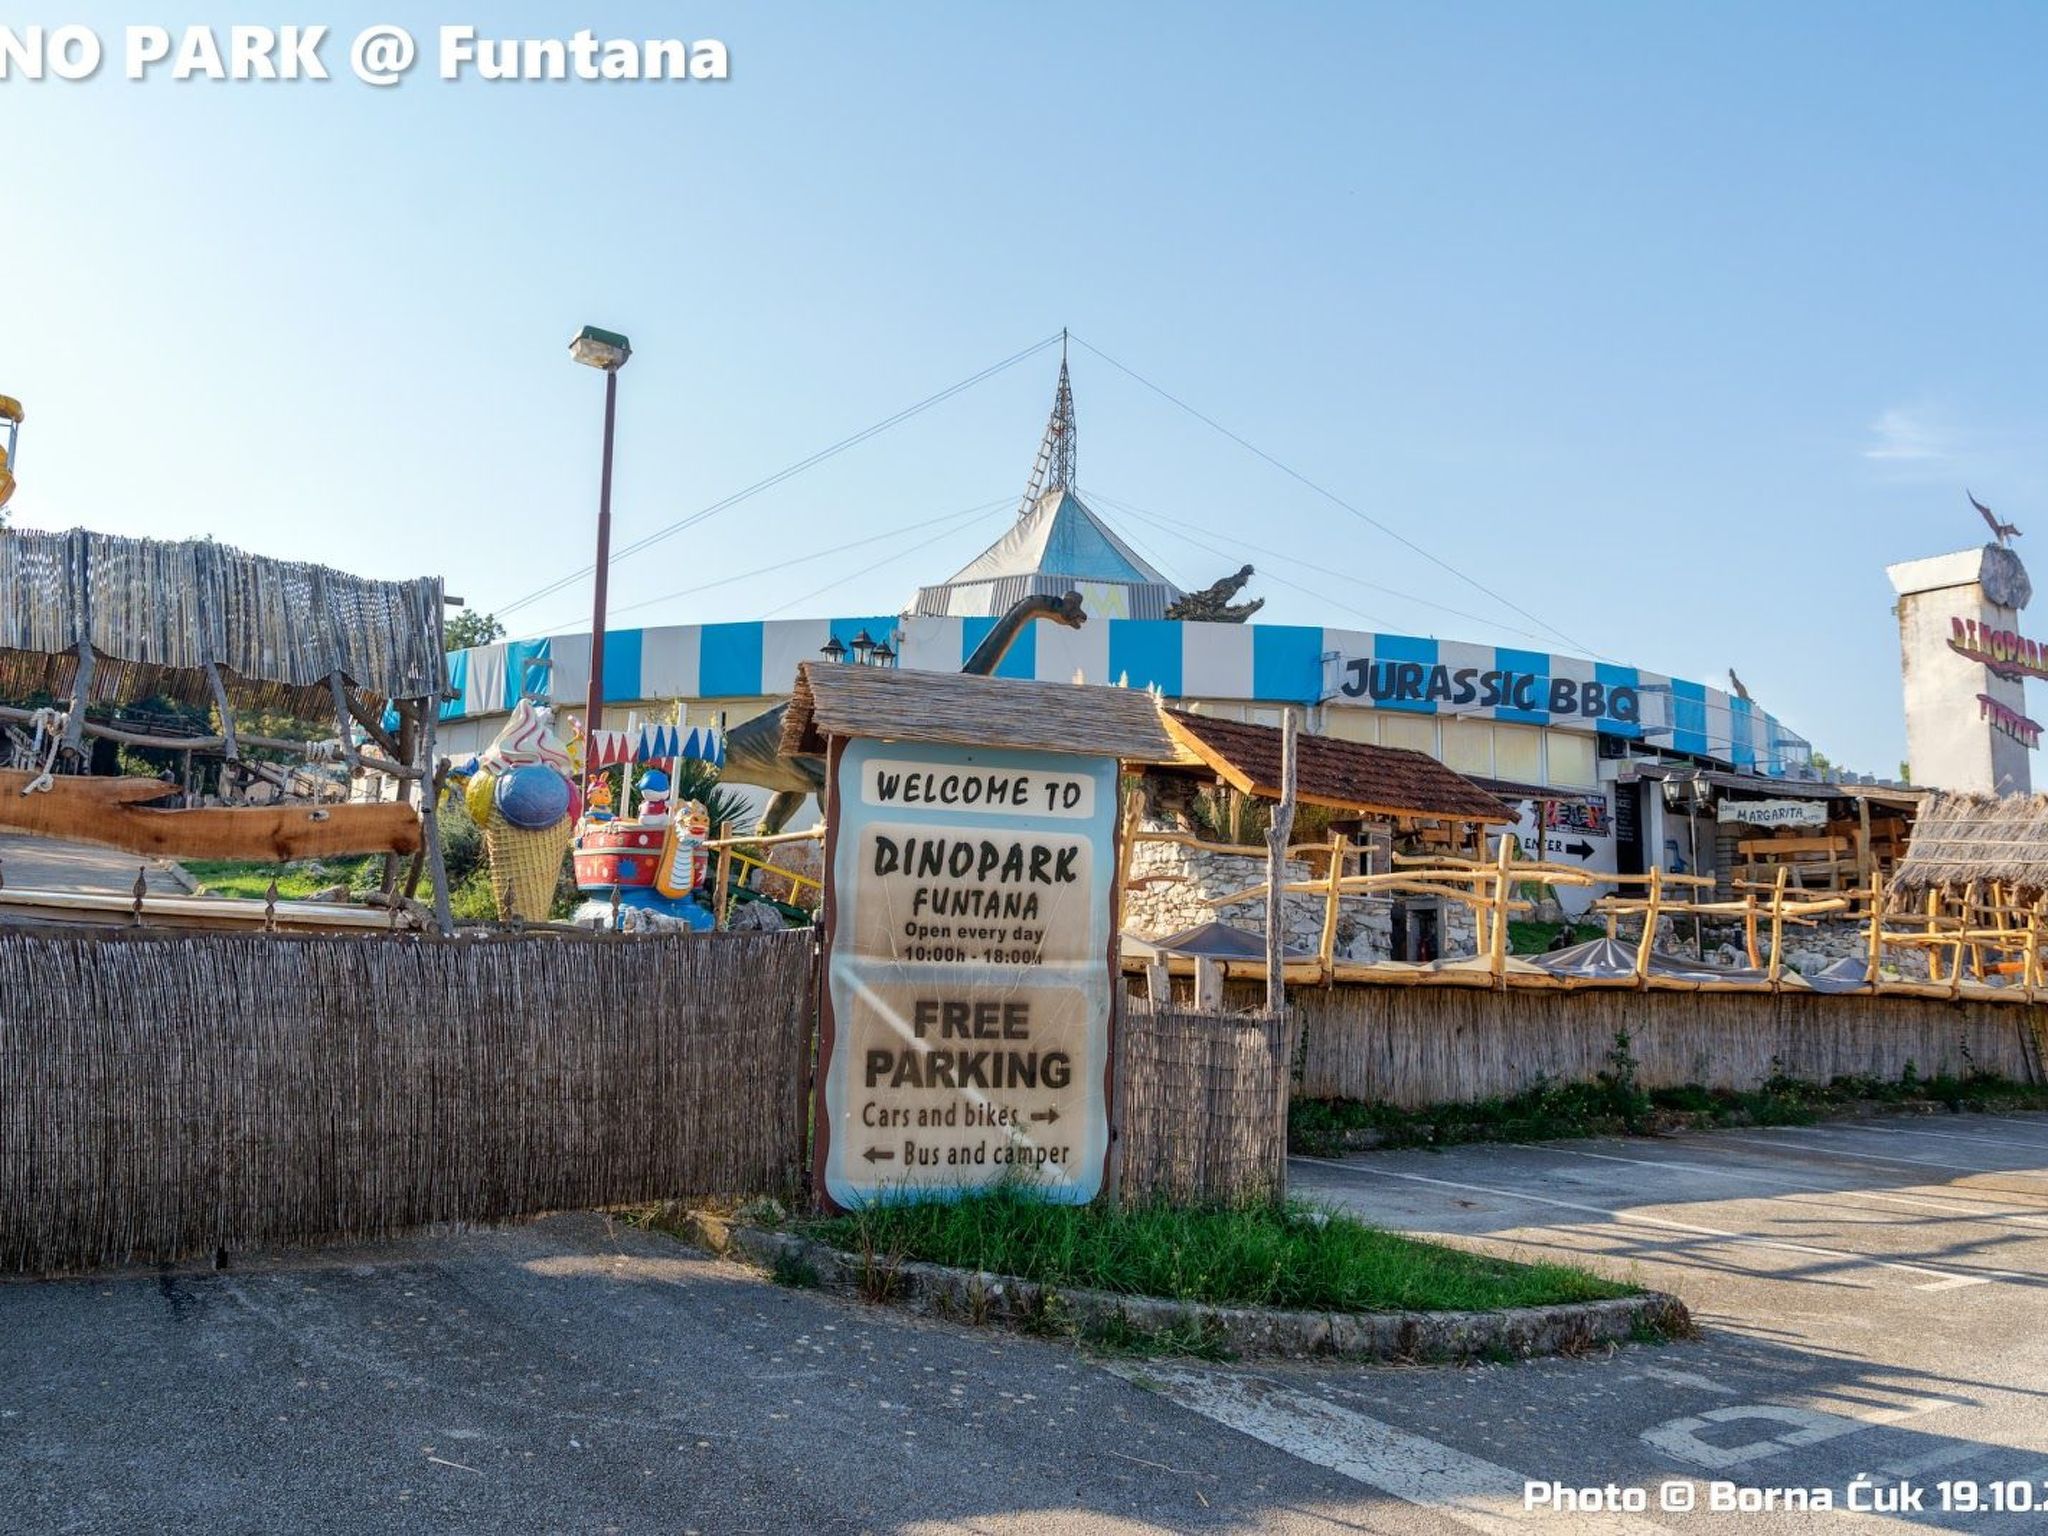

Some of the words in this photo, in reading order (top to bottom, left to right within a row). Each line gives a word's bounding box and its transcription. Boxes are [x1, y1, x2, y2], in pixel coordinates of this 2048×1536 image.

[1341, 657, 1535, 711] JURASSIC
[1550, 678, 1640, 724] BBQ
[877, 771, 1029, 805] WELCOME
[1045, 782, 1081, 810] TO
[1737, 807, 1802, 822] MARGARITA
[874, 835, 1078, 884] DINOPARK
[1524, 837, 1562, 853] ENER
[913, 887, 1039, 920] FUNTANA
[905, 921, 951, 940] Open
[957, 926, 1007, 943] every
[1012, 926, 1044, 944] day
[904, 946, 966, 963] 10:00h
[983, 948, 1042, 965] 18:00h
[914, 1000, 1030, 1040] FREE
[864, 1051, 1072, 1089] PARKING
[862, 1101, 910, 1128] Cars
[918, 1102, 957, 1127] and
[964, 1102, 1018, 1128] bikes
[904, 1140, 940, 1166] Bus
[947, 1141, 986, 1166] and
[993, 1146, 1071, 1170] camper
